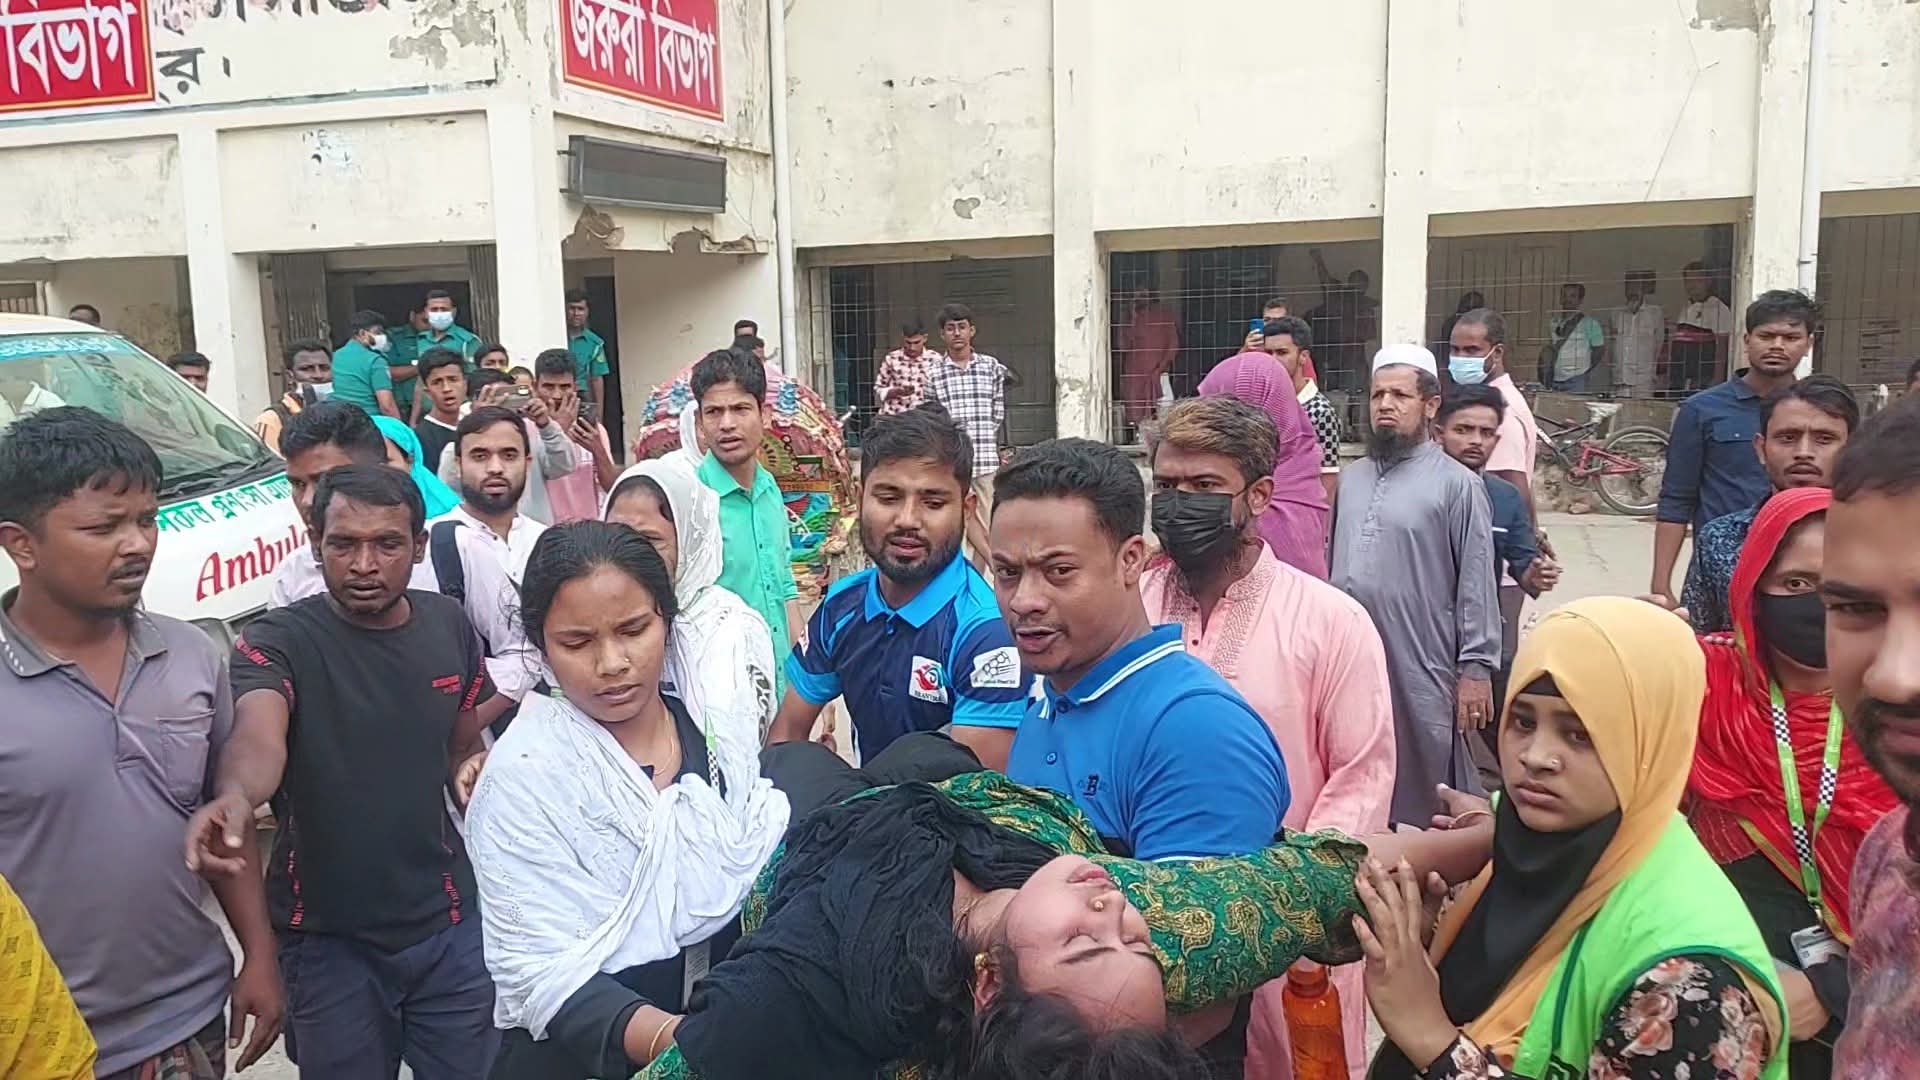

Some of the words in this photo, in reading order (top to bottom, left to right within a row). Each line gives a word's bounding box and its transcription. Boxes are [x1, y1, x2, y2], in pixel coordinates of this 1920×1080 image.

[0, 0, 139, 95] বিভাগ
[649, 0, 716, 106] বিভাগ
[196, 523, 308, 602] Ambul
